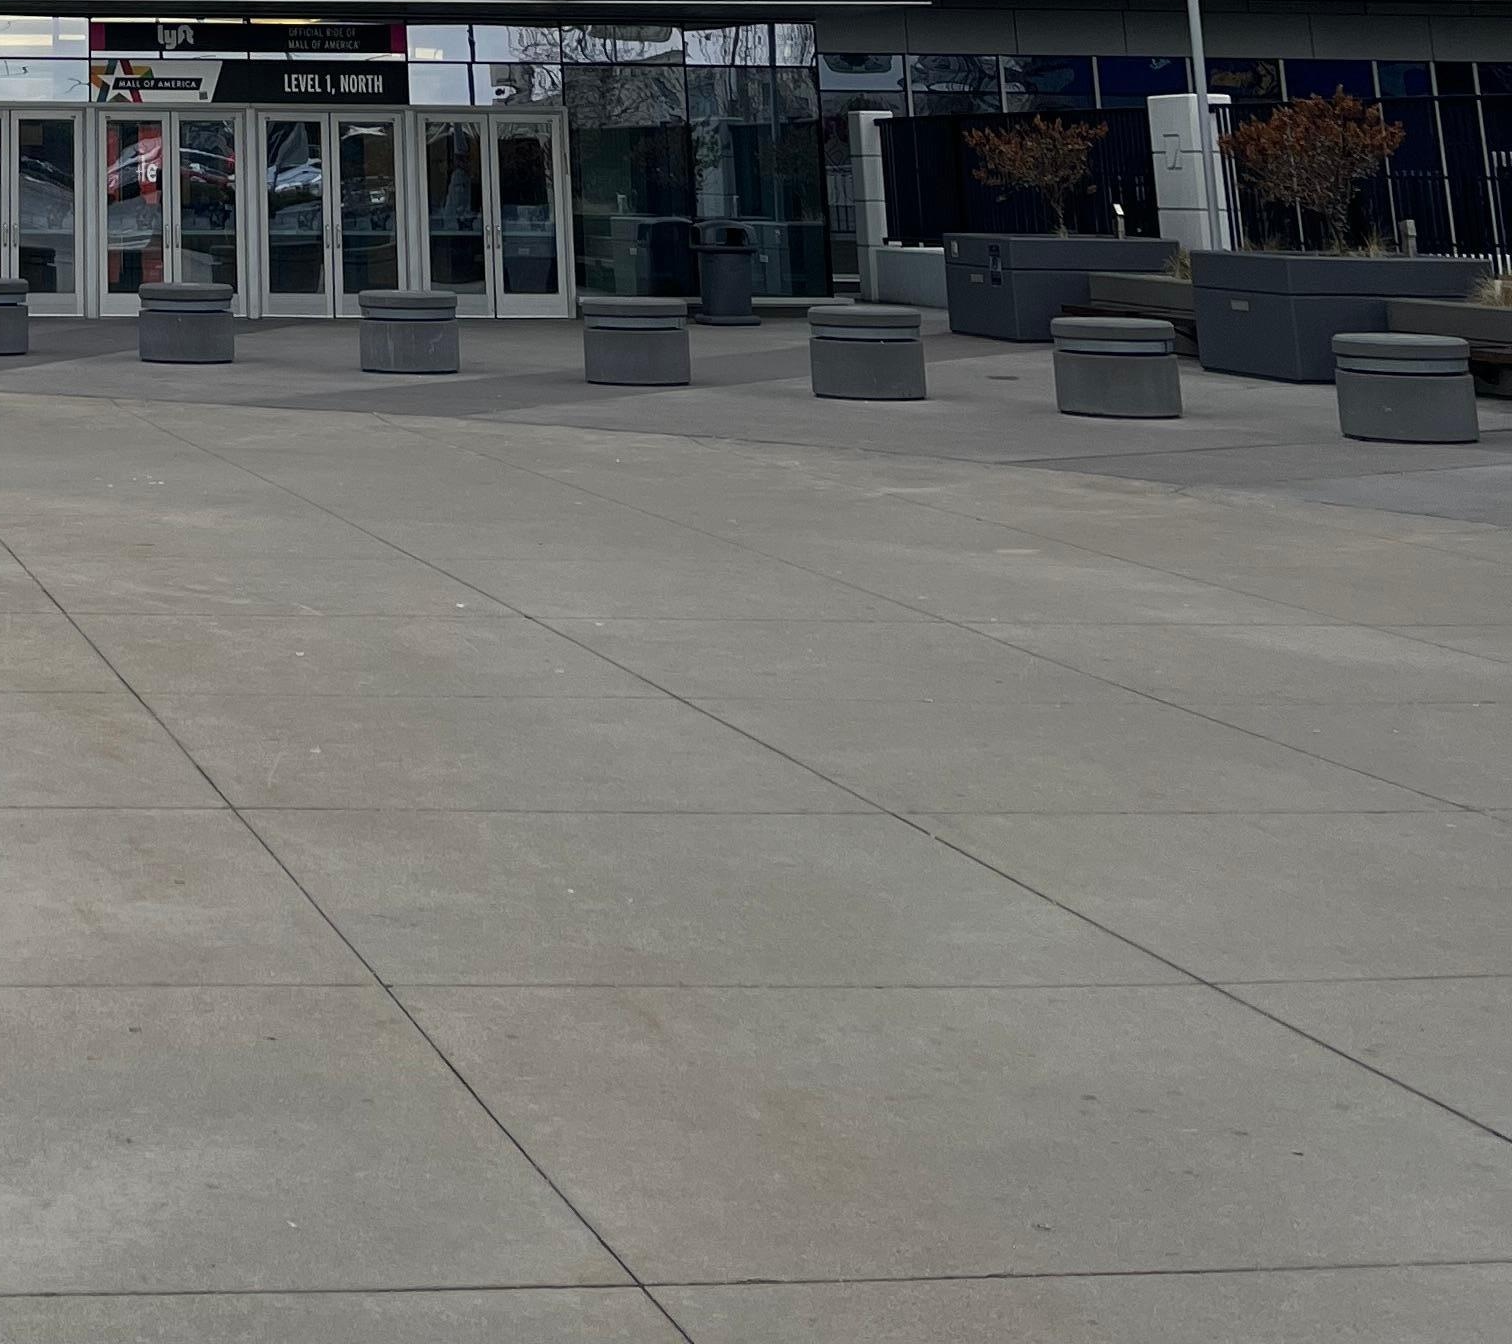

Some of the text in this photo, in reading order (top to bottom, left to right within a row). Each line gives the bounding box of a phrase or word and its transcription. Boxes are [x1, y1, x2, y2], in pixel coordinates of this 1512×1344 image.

[157, 24, 196, 50] lyft
[288, 39, 359, 50] MALL OF AMERICA
[118, 80, 197, 88] MALL OF AMERICA
[284, 74, 383, 95] LEVEL 1, NORTH
